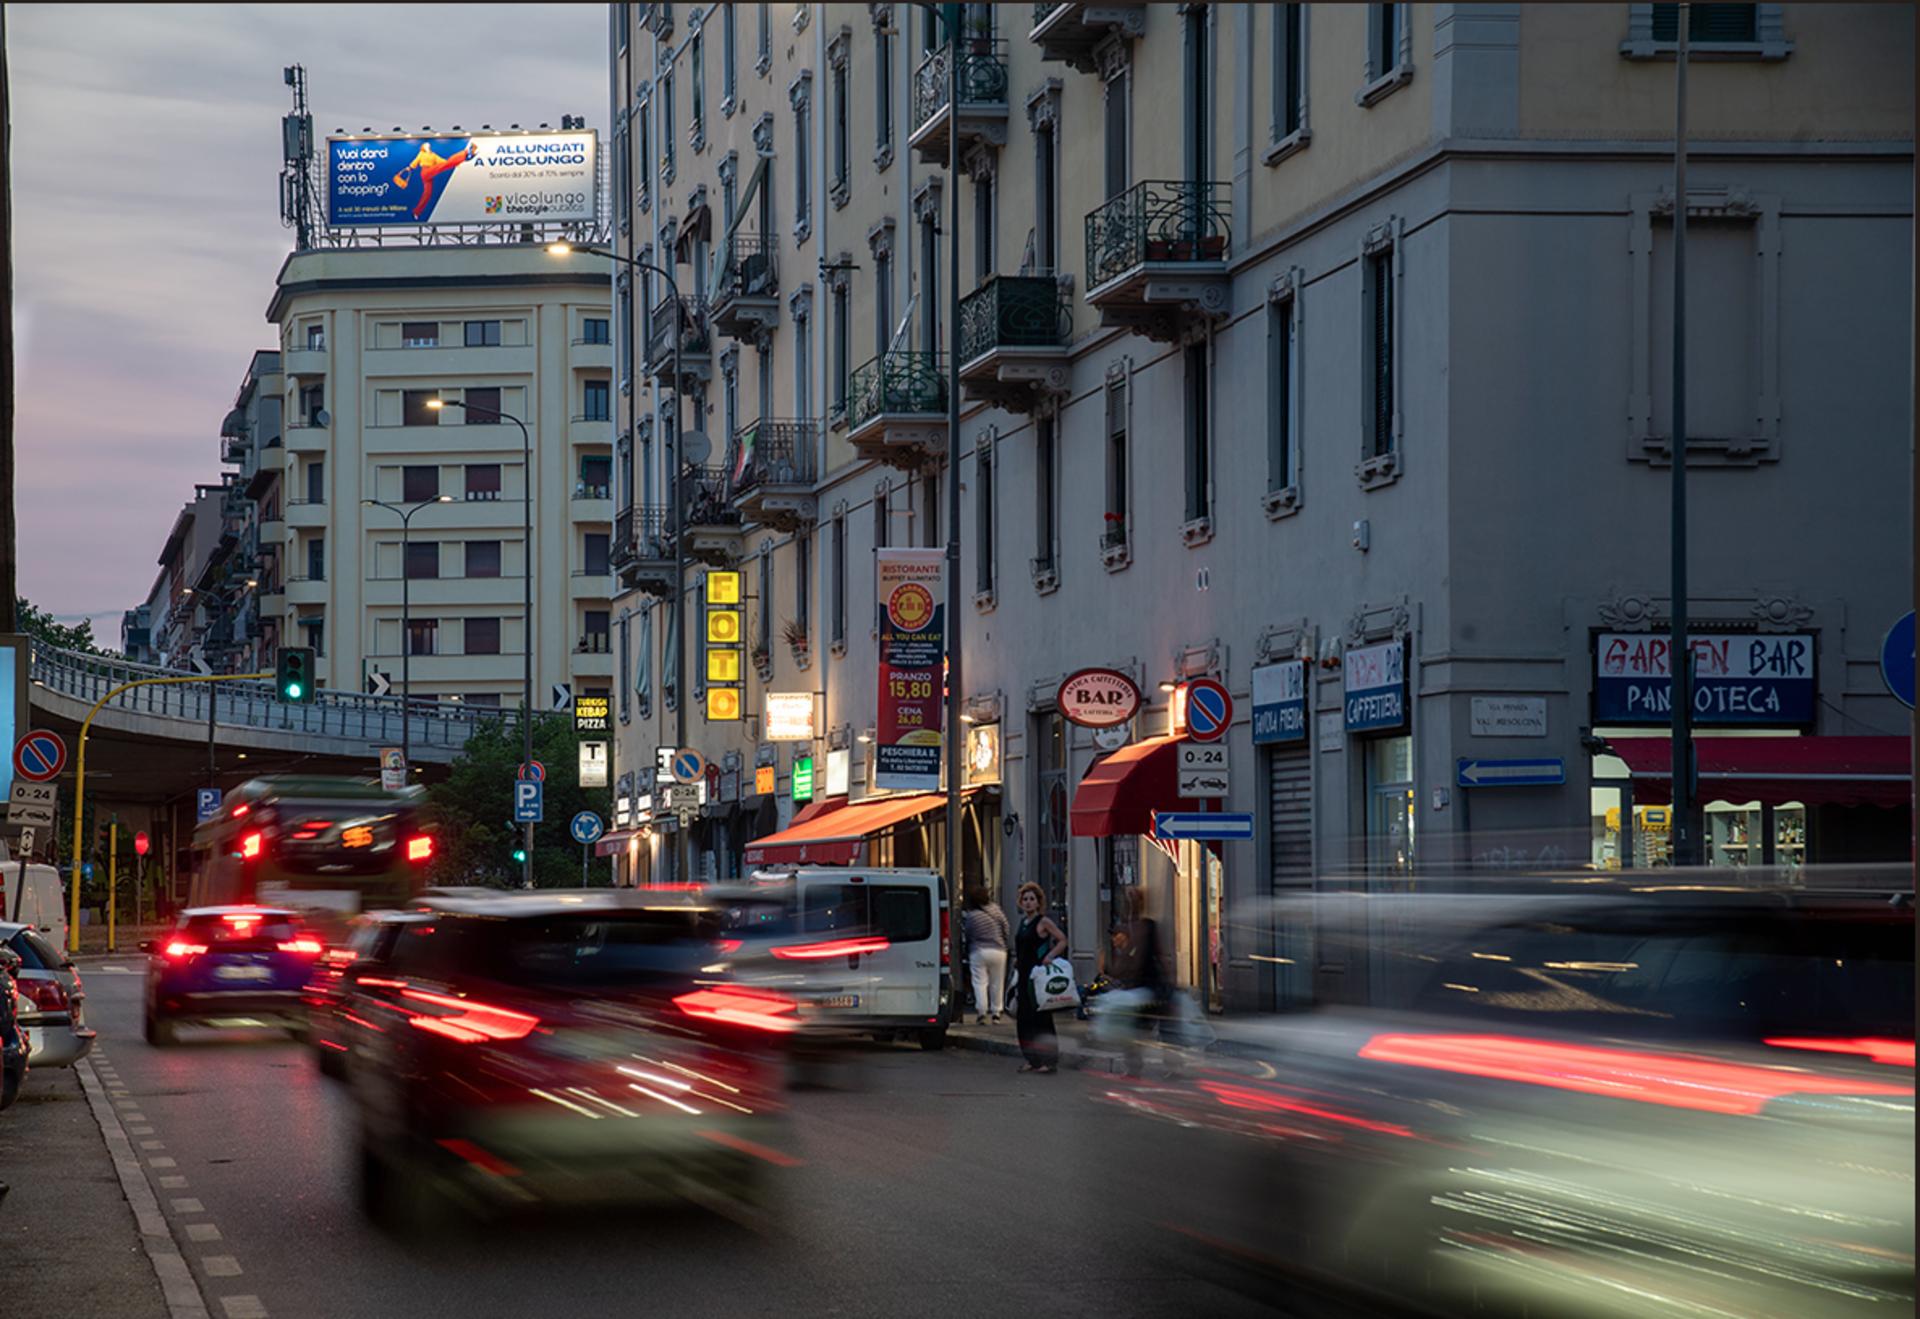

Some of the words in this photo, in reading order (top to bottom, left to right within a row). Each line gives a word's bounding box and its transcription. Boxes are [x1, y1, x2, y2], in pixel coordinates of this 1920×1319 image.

[337, 148, 358, 159] Vuoi
[497, 143, 584, 154] ALLUNGATI
[338, 160, 374, 171] dentro
[474, 157, 484, 166] A
[488, 154, 585, 166] VICOLUNGO
[338, 174, 356, 183] con
[358, 172, 368, 182] lo
[338, 182, 390, 196] shopping?
[505, 192, 585, 206] vicolungo
[882, 564, 940, 574] RISTORANTE
[881, 633, 895, 641] ALL
[912, 633, 926, 641] CAN
[710, 575, 736, 716] FOTO
[1604, 638, 1730, 675] GAREN
[1748, 639, 1805, 676] BAR
[890, 672, 931, 681] PRANZO
[889, 682, 931, 699] 15,80
[1066, 678, 1089, 695] ANTICA
[577, 698, 607, 706] TURKISH
[1076, 690, 1123, 705] BAR
[1627, 685, 1781, 713] PANOTECA
[576, 707, 608, 718] KEBAP
[897, 706, 922, 714] CENA
[578, 719, 606, 729] PIZZA
[586, 744, 601, 760] T
[201, 792, 214, 807] P
[519, 784, 537, 808] P
